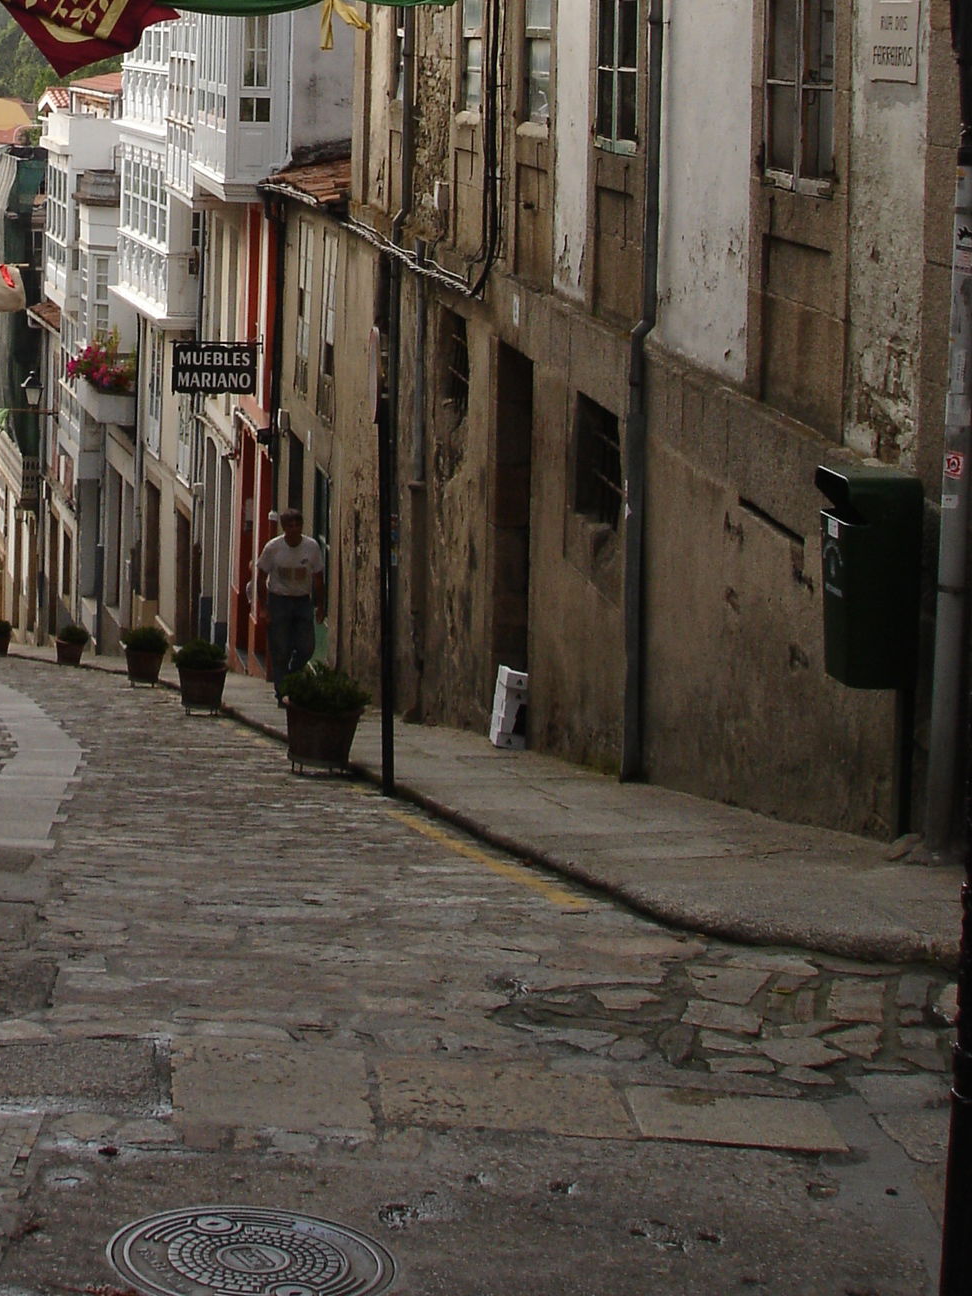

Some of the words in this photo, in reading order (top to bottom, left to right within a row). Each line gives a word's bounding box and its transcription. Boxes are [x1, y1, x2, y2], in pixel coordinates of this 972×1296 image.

[880, 15, 893, 31] RUA
[872, 45, 913, 67] FERREIROS
[178, 351, 251, 366] MUEBLES
[177, 371, 251, 388] MARIANO
